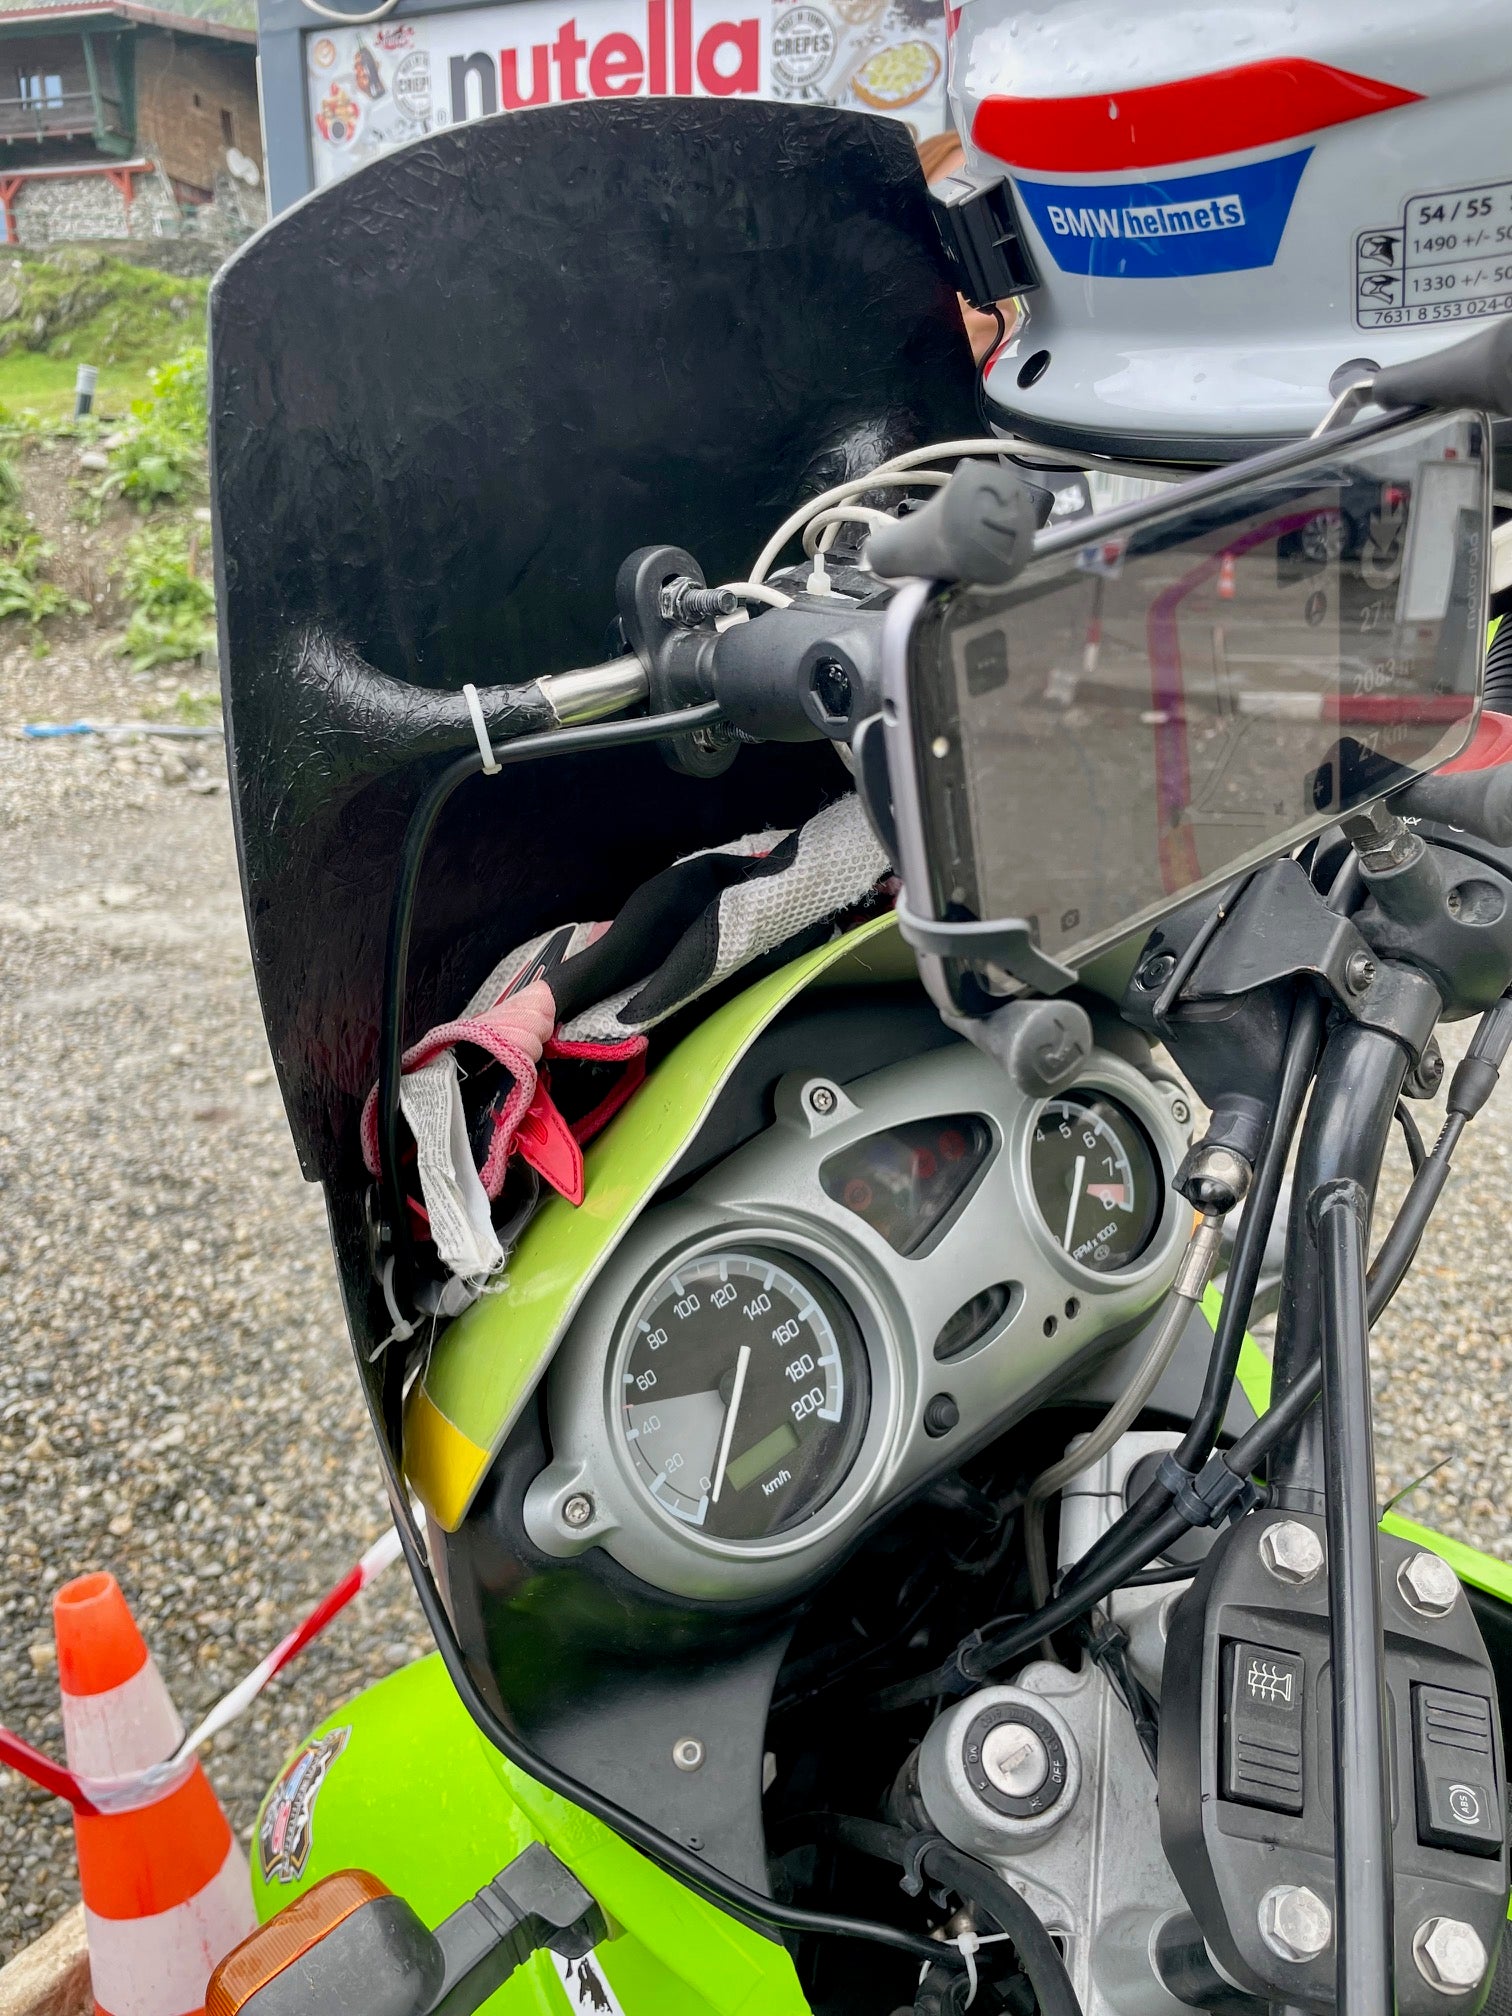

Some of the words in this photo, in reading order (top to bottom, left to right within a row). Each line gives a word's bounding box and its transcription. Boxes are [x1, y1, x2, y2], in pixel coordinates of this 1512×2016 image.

[774, 34, 830, 56] CREPES
[449, 0, 760, 124] nutella
[1413, 234, 1457, 254] 1490
[1413, 274, 1456, 293] 1330
[1374, 309, 1411, 325] 7631
[1418, 307, 1427, 321] 8
[1432, 303, 1462, 320] 553
[1466, 532, 1482, 631] motorola
[1035, 1128, 1046, 1143] 4
[1058, 1122, 1073, 1140] 5
[1082, 1130, 1097, 1149] 6
[1101, 1156, 1114, 1178] 7
[673, 1293, 701, 1320] 100
[710, 1283, 738, 1310] 120
[742, 1293, 772, 1321] 140
[646, 1327, 669, 1351] 80
[771, 1318, 800, 1347] 160
[784, 1353, 815, 1383] 180
[635, 1369, 658, 1392] 60
[790, 1387, 825, 1422] 200
[641, 1415, 662, 1436] 40
[664, 1452, 685, 1475] 20
[699, 1475, 712, 1491] 0
[761, 1468, 792, 1497] km/h
[968, 1745, 979, 1764] ON
[1051, 1760, 1064, 1784] OFF
[1459, 1795, 1470, 1814] ABS
